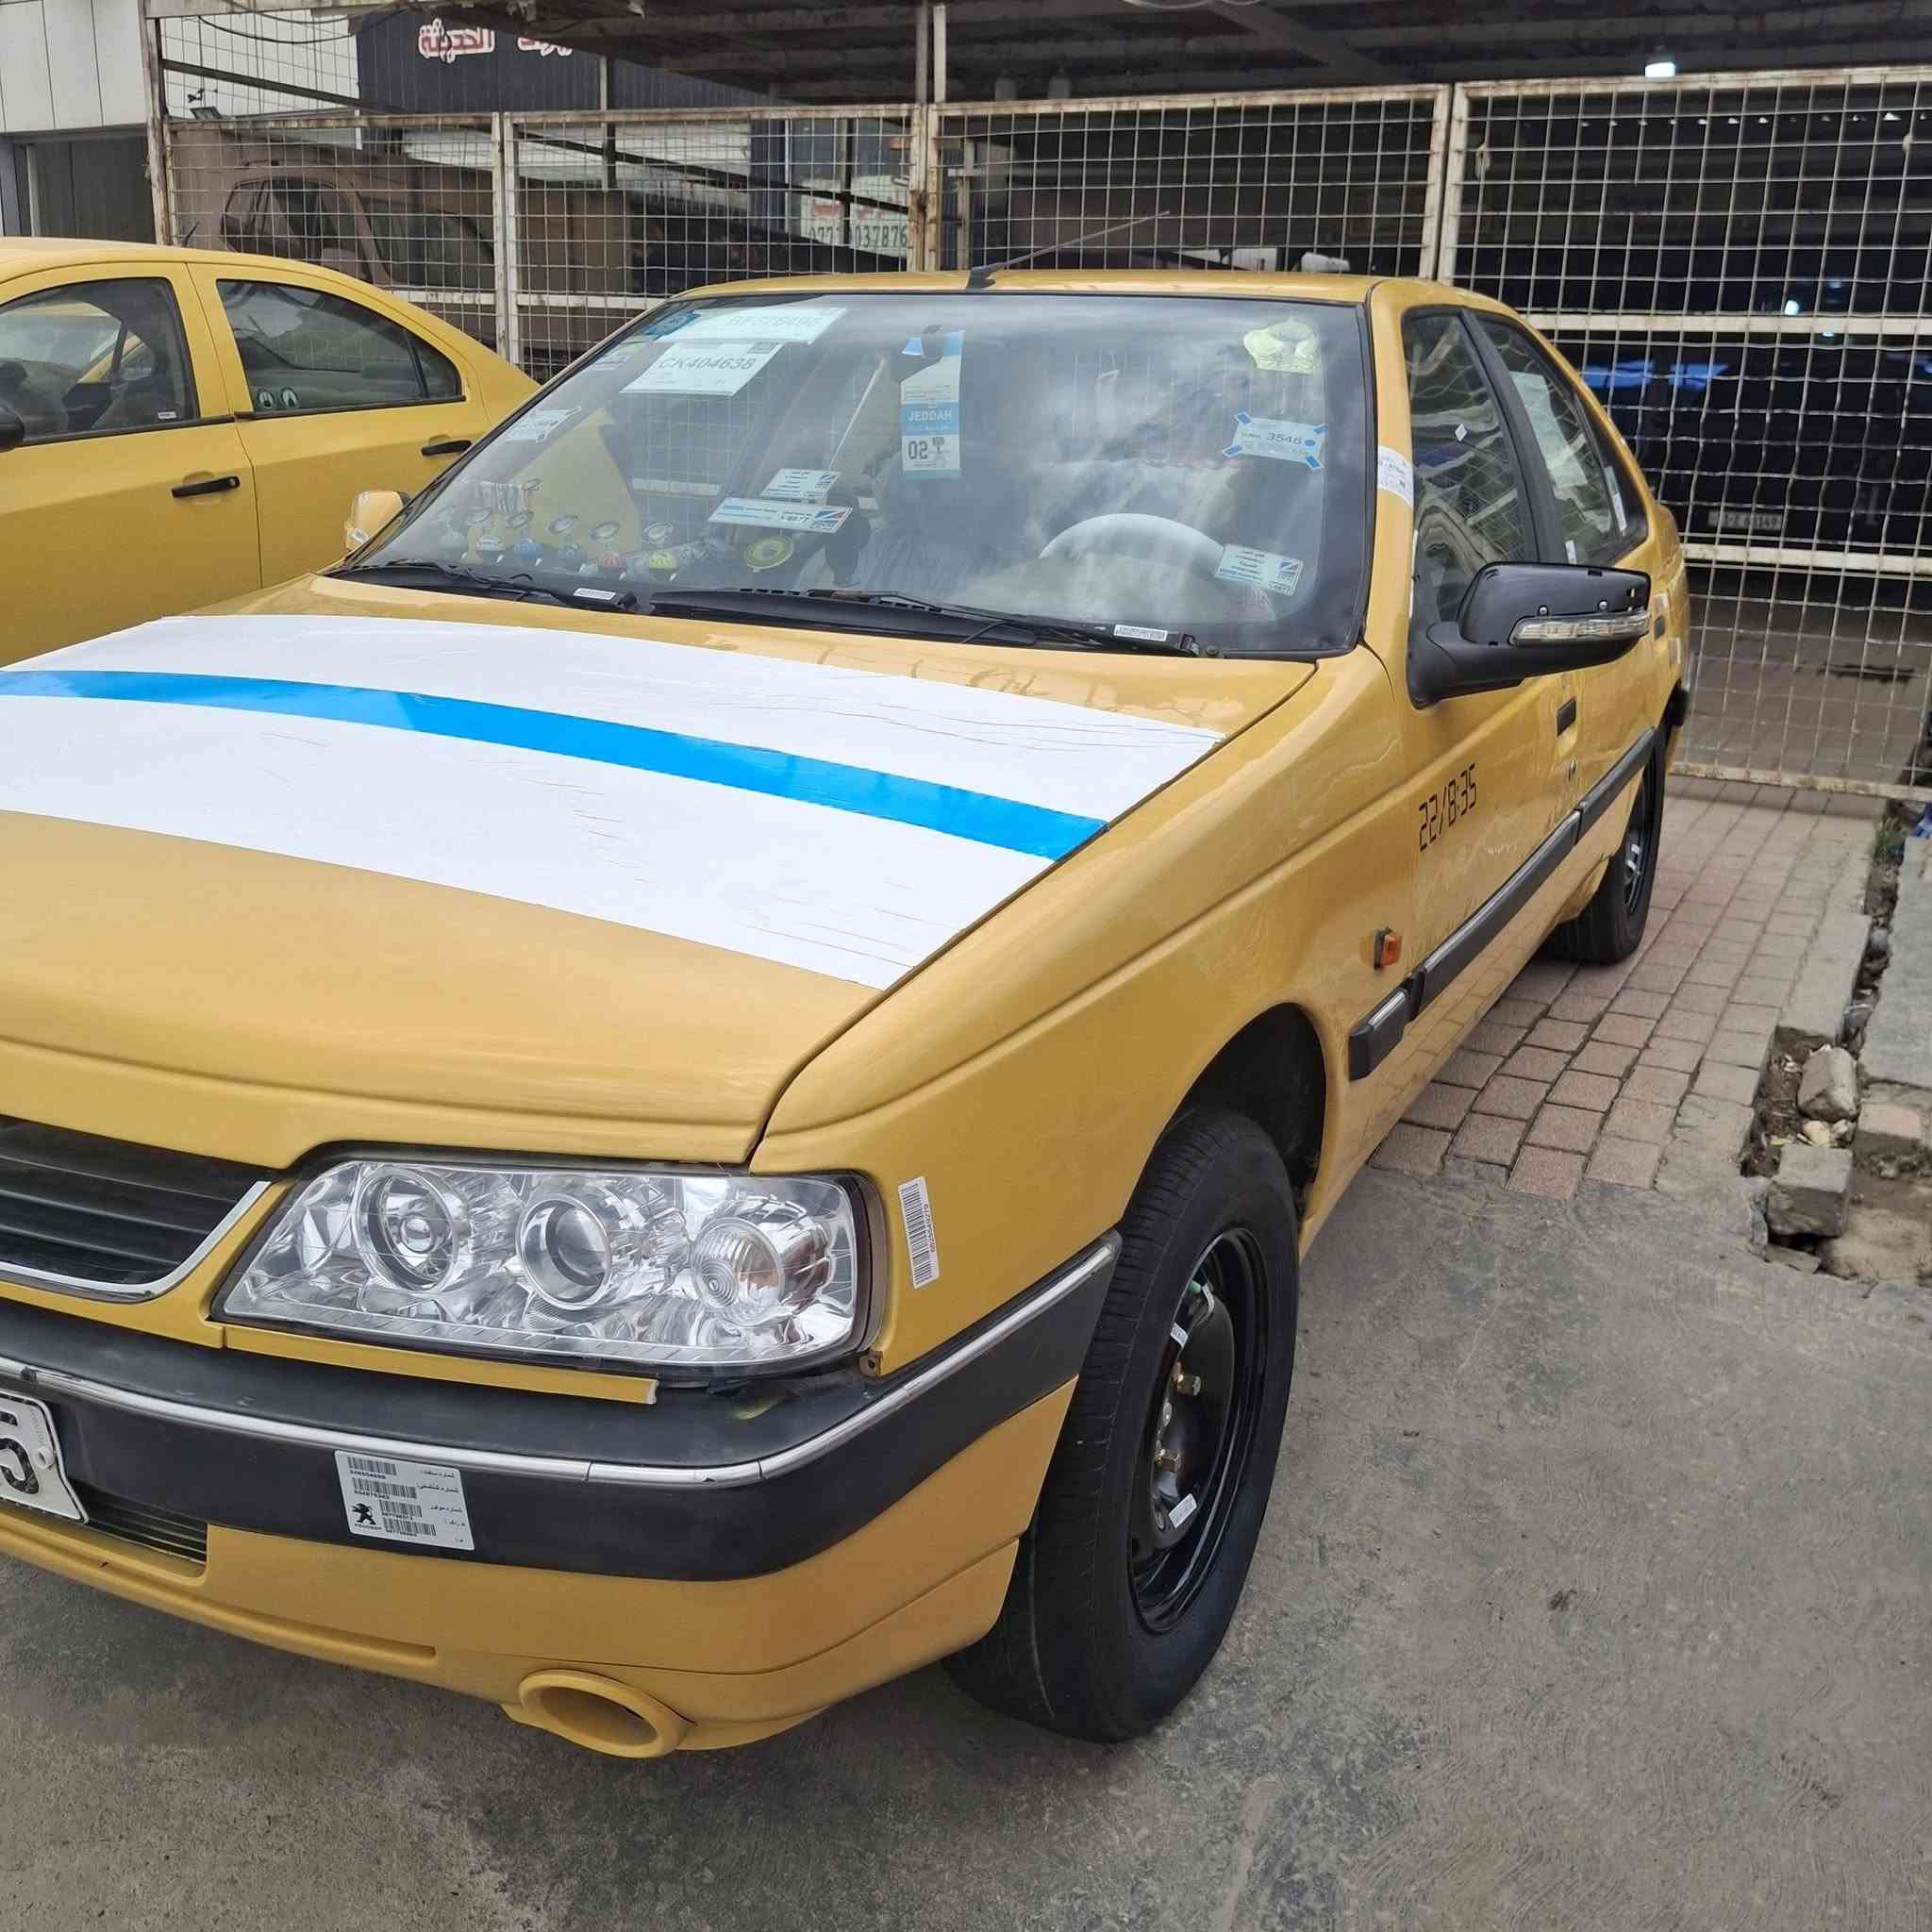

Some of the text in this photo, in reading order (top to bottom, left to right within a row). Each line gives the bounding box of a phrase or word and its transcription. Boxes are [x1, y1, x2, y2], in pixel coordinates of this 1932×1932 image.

[658, 355, 757, 370] CK404638
[908, 409, 952, 423] JEDDAH
[1267, 431, 1303, 445] 3546
